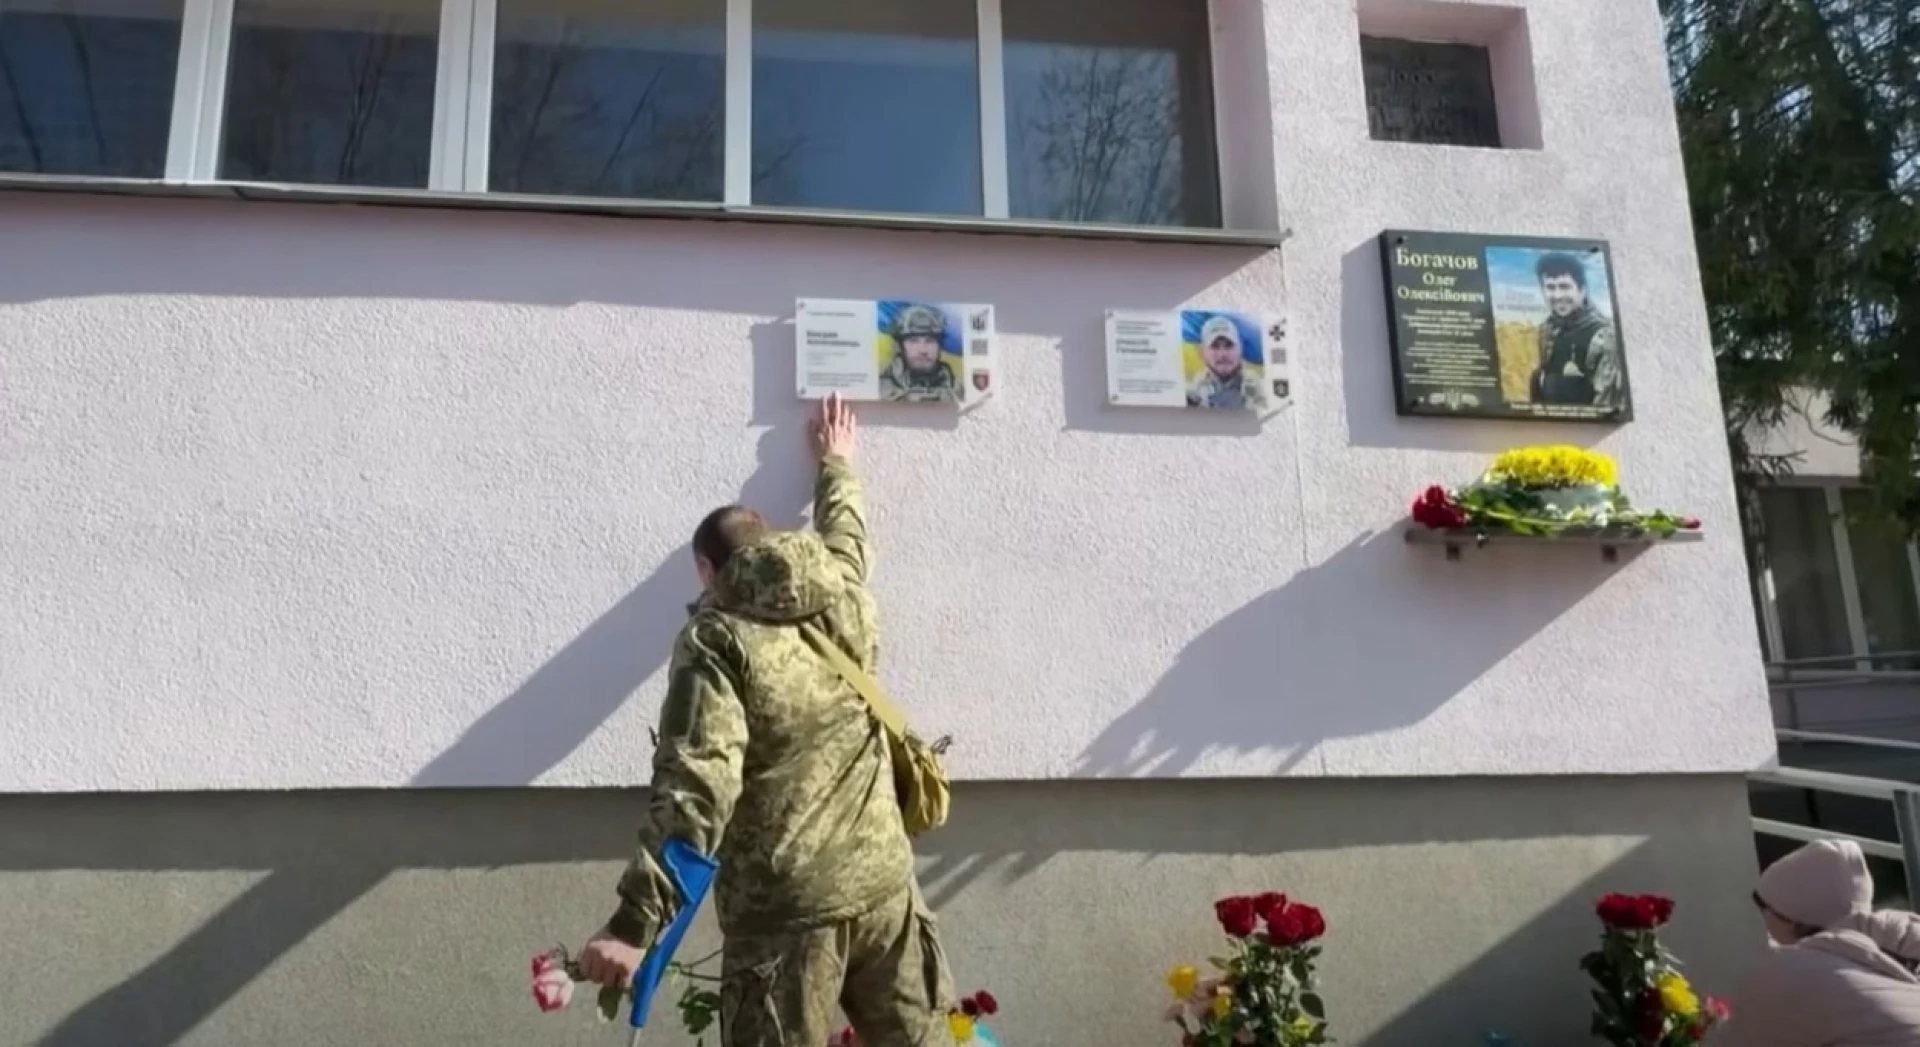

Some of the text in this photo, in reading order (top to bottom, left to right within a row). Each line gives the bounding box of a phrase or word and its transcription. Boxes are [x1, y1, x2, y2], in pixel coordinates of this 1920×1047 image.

[1397, 247, 1478, 270] Богачов
[1423, 272, 1457, 286] Олег
[1398, 285, 1485, 303] Олексійович
